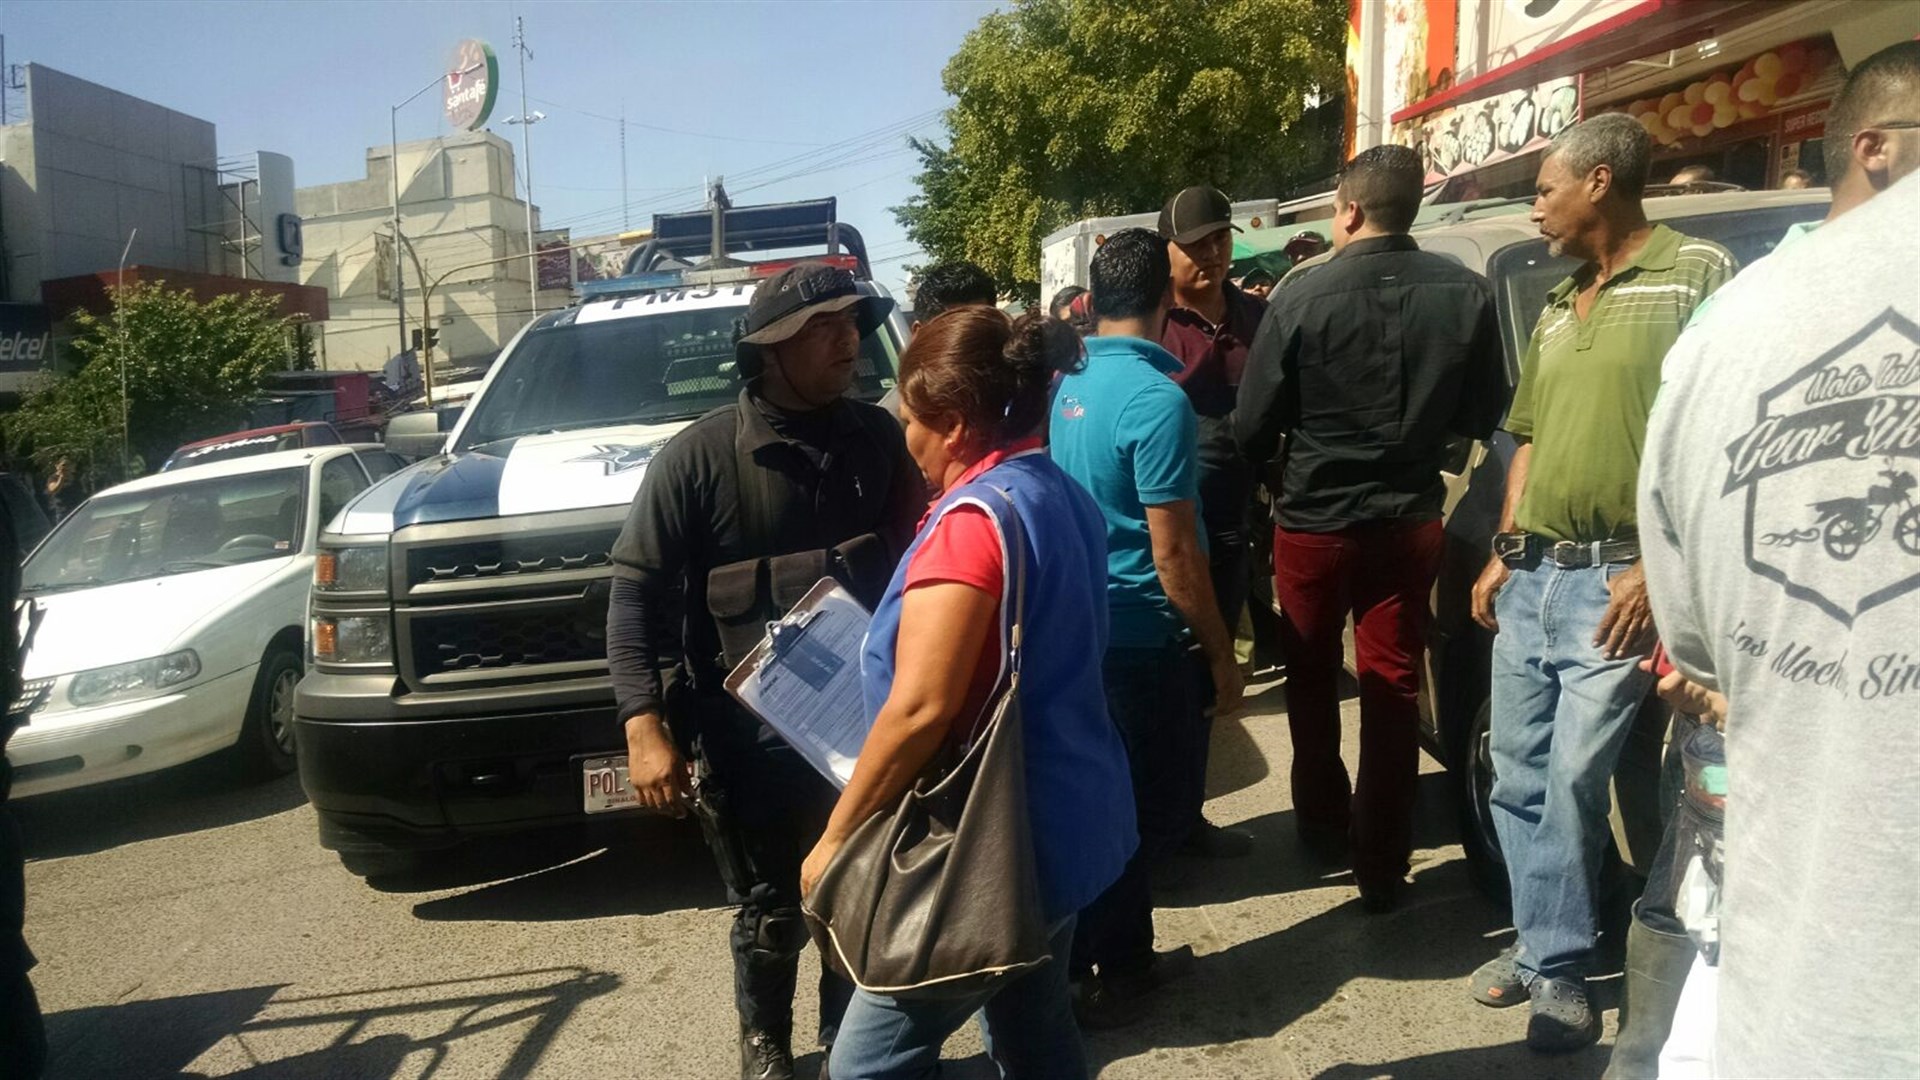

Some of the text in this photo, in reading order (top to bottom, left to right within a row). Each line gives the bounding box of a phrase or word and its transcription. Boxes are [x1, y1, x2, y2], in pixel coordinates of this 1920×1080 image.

[0, 331, 49, 360] elcel
[587, 771, 626, 798] POL
[606, 795, 636, 805] SINALO
